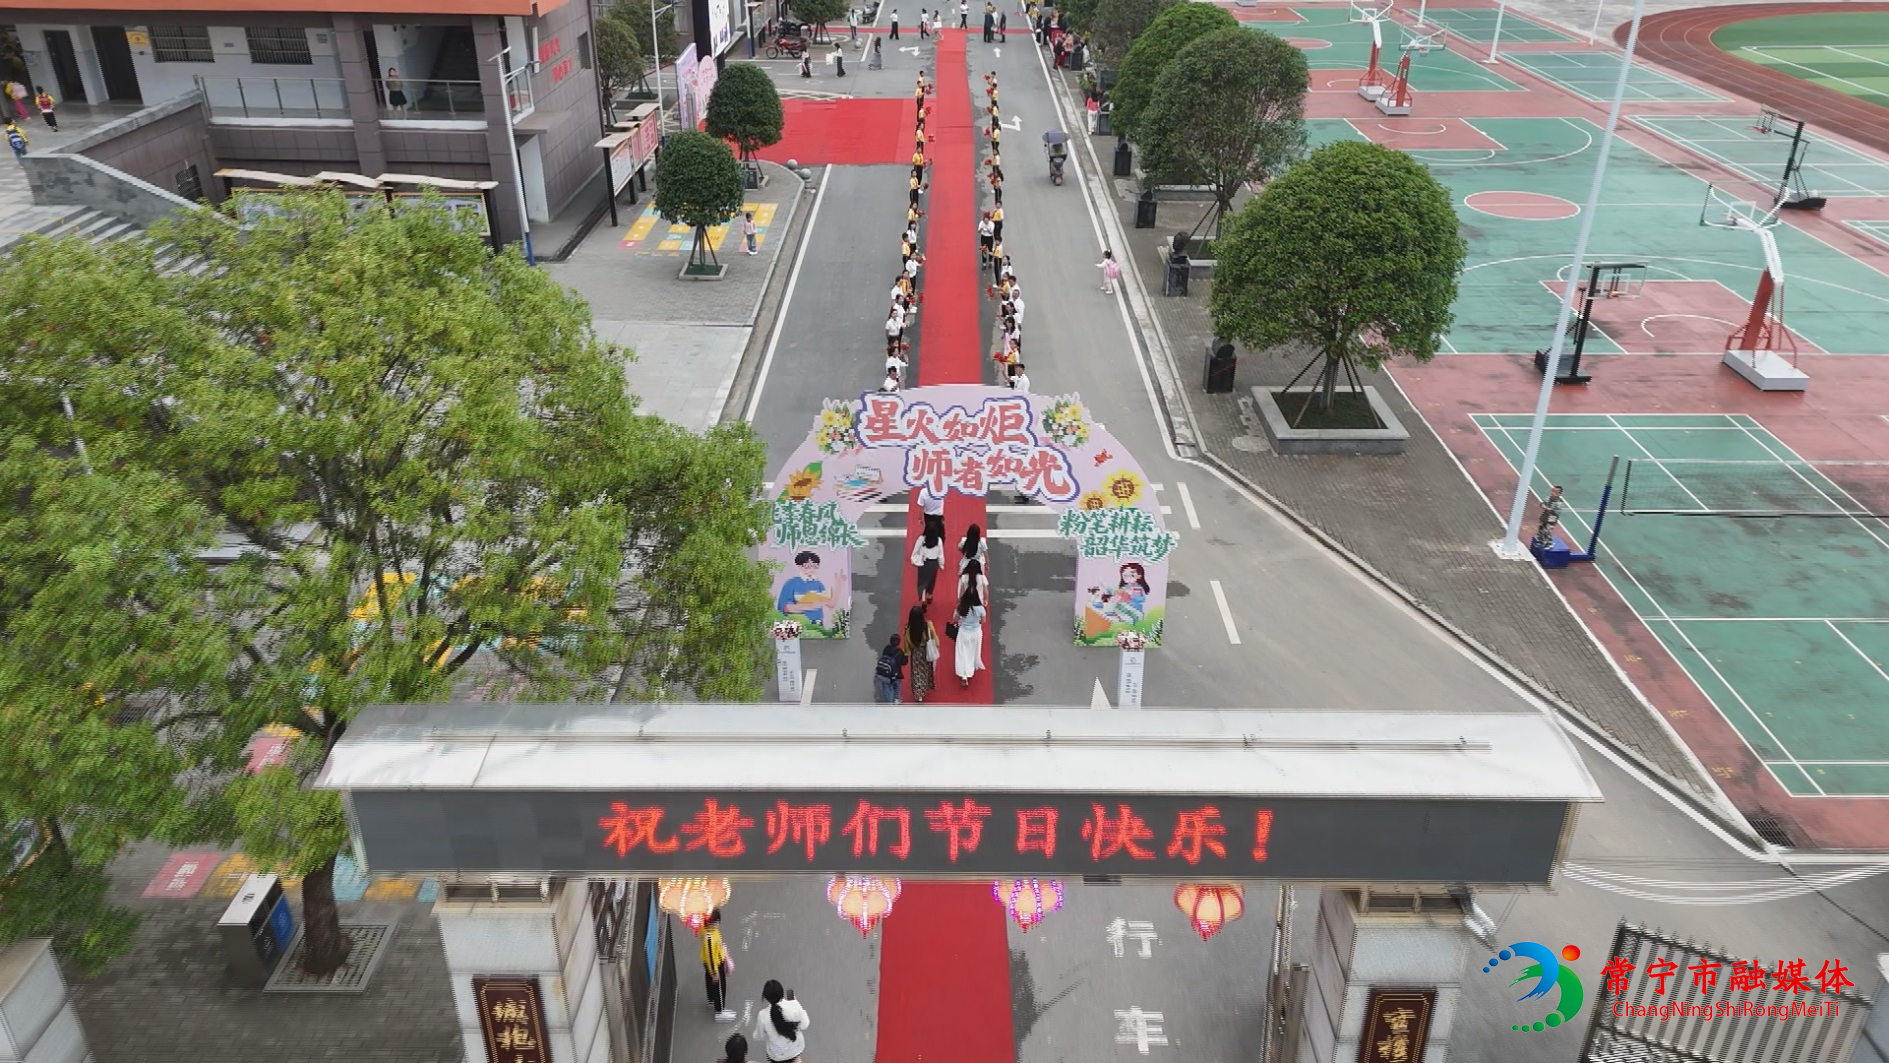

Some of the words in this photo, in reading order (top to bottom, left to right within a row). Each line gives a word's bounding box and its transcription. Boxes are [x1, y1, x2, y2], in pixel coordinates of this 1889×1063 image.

[865, 399, 1030, 445] 星火如炬
[911, 446, 1072, 496] 师者如光
[773, 519, 866, 550] 师恩绵长
[1060, 507, 1154, 536] 粉笔耕耘
[1080, 533, 1176, 562] 韶华筑梦
